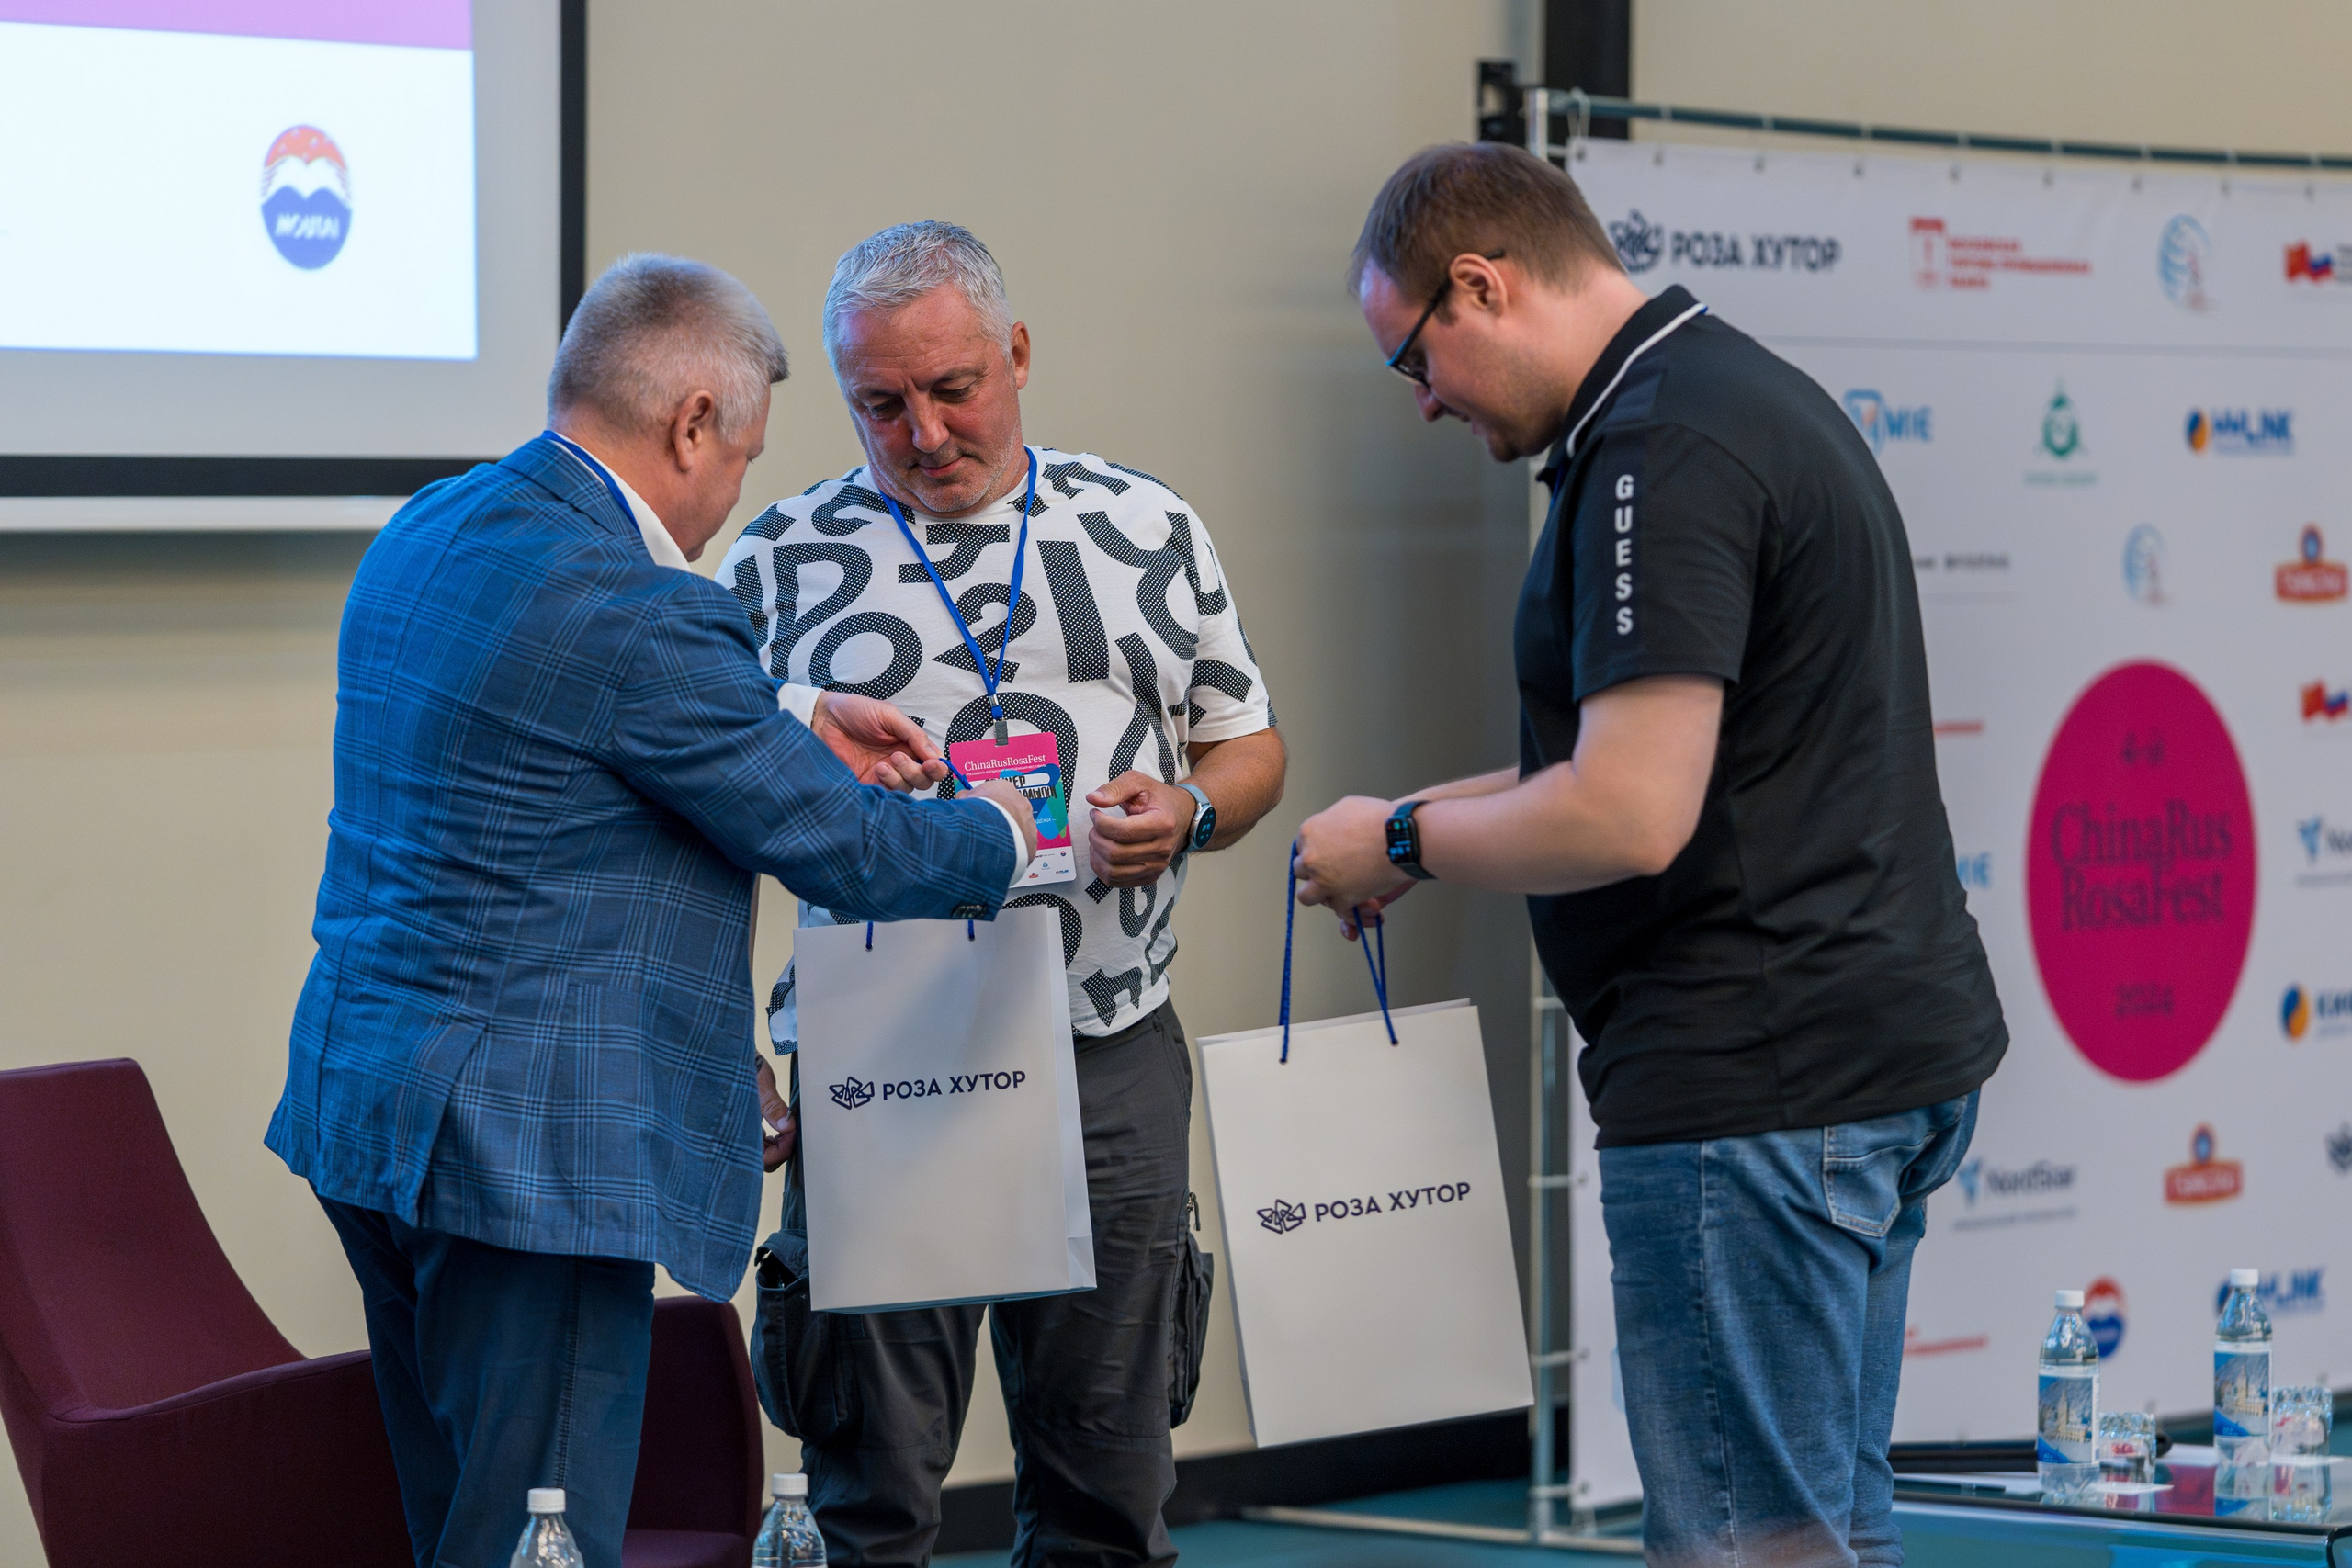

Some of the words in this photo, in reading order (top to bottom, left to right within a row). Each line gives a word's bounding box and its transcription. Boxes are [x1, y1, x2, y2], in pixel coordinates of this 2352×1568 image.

[1670, 231, 1745, 269] РОЗА
[1749, 232, 1843, 273] ХУТОР
[1614, 474, 1634, 636] GUESS
[964, 754, 1046, 772] ChinaRusRosaFest
[2051, 799, 2233, 867] ChinaRus
[2062, 864, 2224, 932] RosaFest
[882, 1077, 943, 1101] РОЗА
[949, 1070, 1026, 1095] ХУТОР
[1315, 1196, 1382, 1223] РОЗА
[1387, 1181, 1471, 1212] ХУТОР
